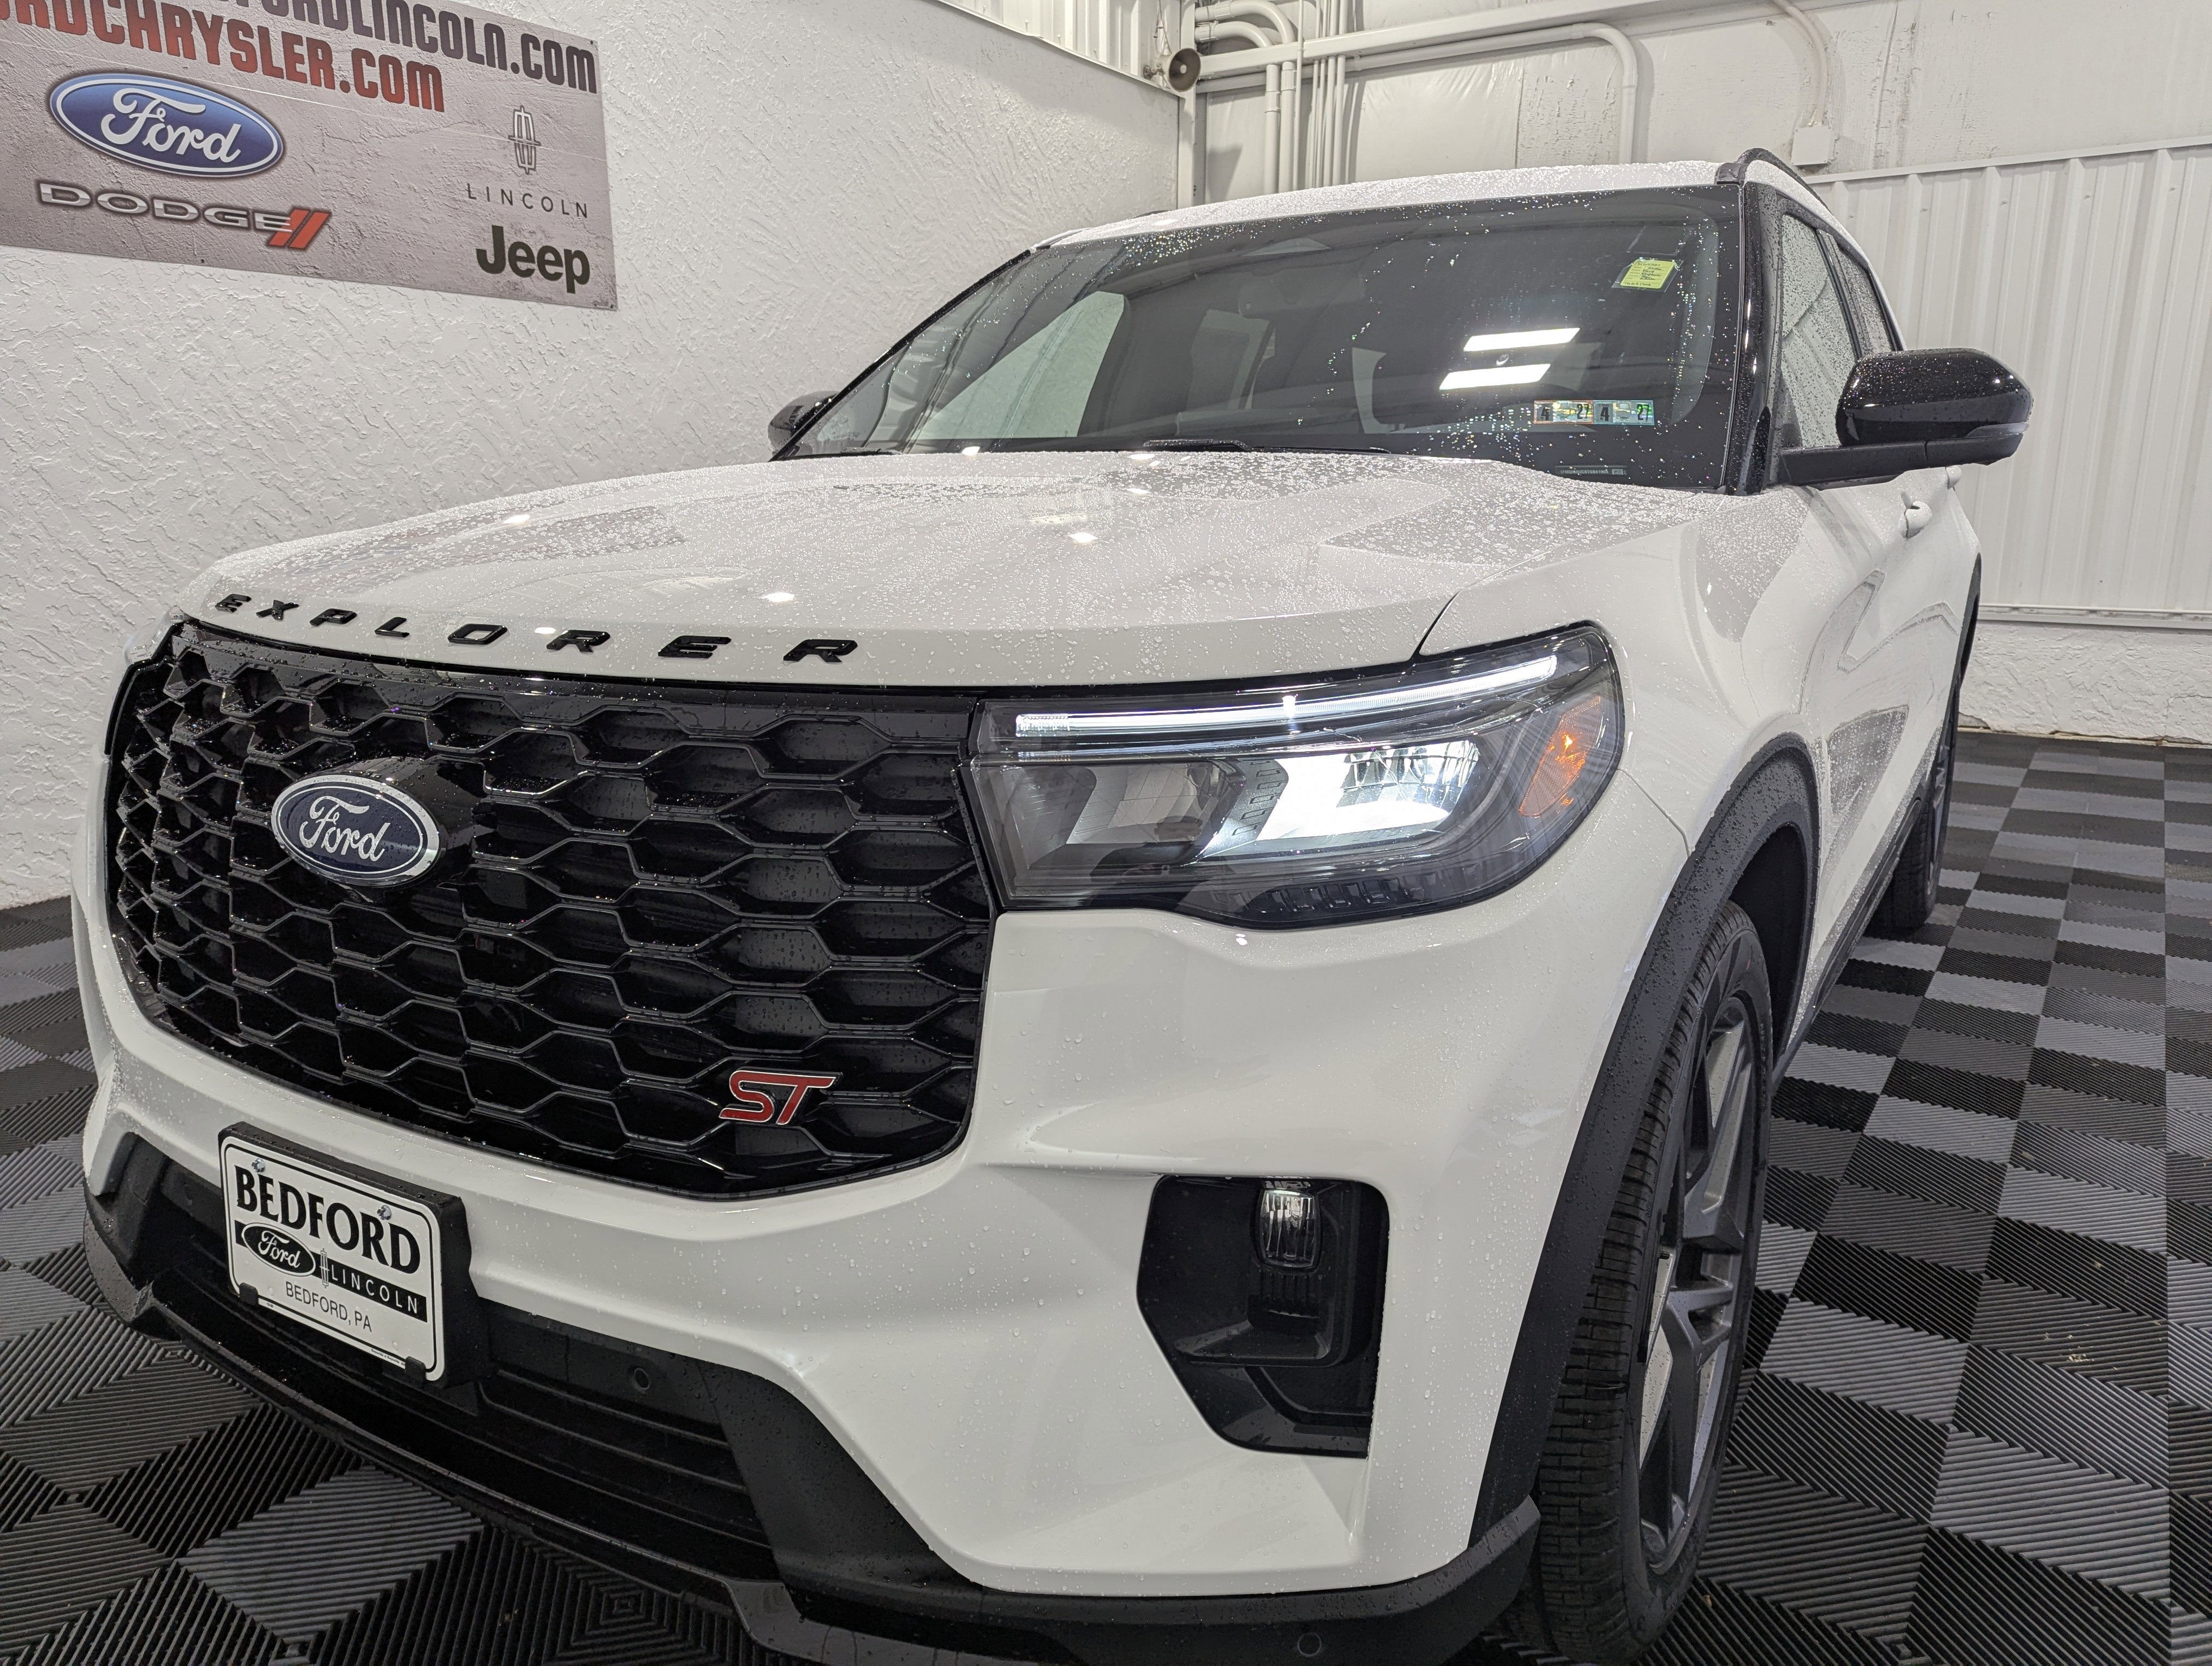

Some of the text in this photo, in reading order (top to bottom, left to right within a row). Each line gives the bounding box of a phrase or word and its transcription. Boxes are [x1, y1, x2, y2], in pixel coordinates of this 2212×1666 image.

[101, 88, 242, 163] Ford
[40, 183, 294, 233] DODGE
[467, 183, 588, 218] LINCOLN
[475, 225, 590, 294] Jeep
[1541, 404, 1589, 420] 4 27
[1600, 404, 1650, 421] 4 27
[215, 593, 858, 664] EXPLORER
[299, 796, 390, 862] Ford
[719, 1070, 837, 1125] ST
[234, 1165, 420, 1274] BEDFORD
[258, 1230, 417, 1315] Ford LINCOLN
[286, 1281, 372, 1332] BEDFORD, PA
